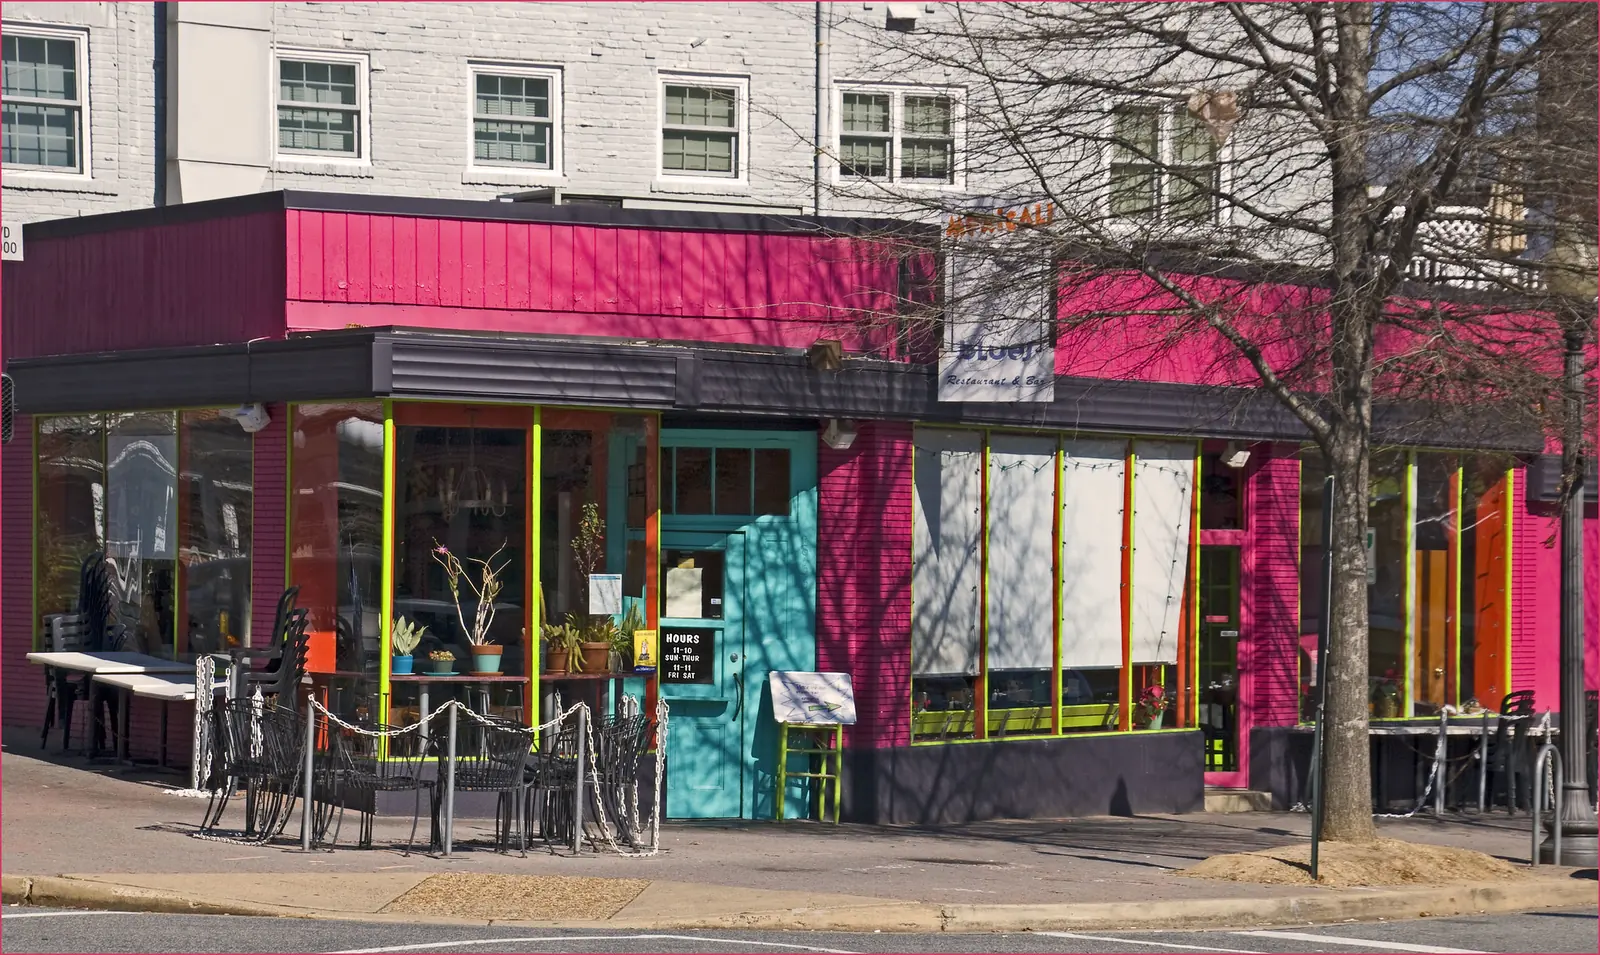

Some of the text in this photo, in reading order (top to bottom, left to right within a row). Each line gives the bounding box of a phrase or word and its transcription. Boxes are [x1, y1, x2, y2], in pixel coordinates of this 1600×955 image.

[946, 375, 1006, 386] Restaurant
[1012, 376, 1021, 386] &
[666, 633, 700, 644] HOURS
[673, 664, 692, 672] 11-11
